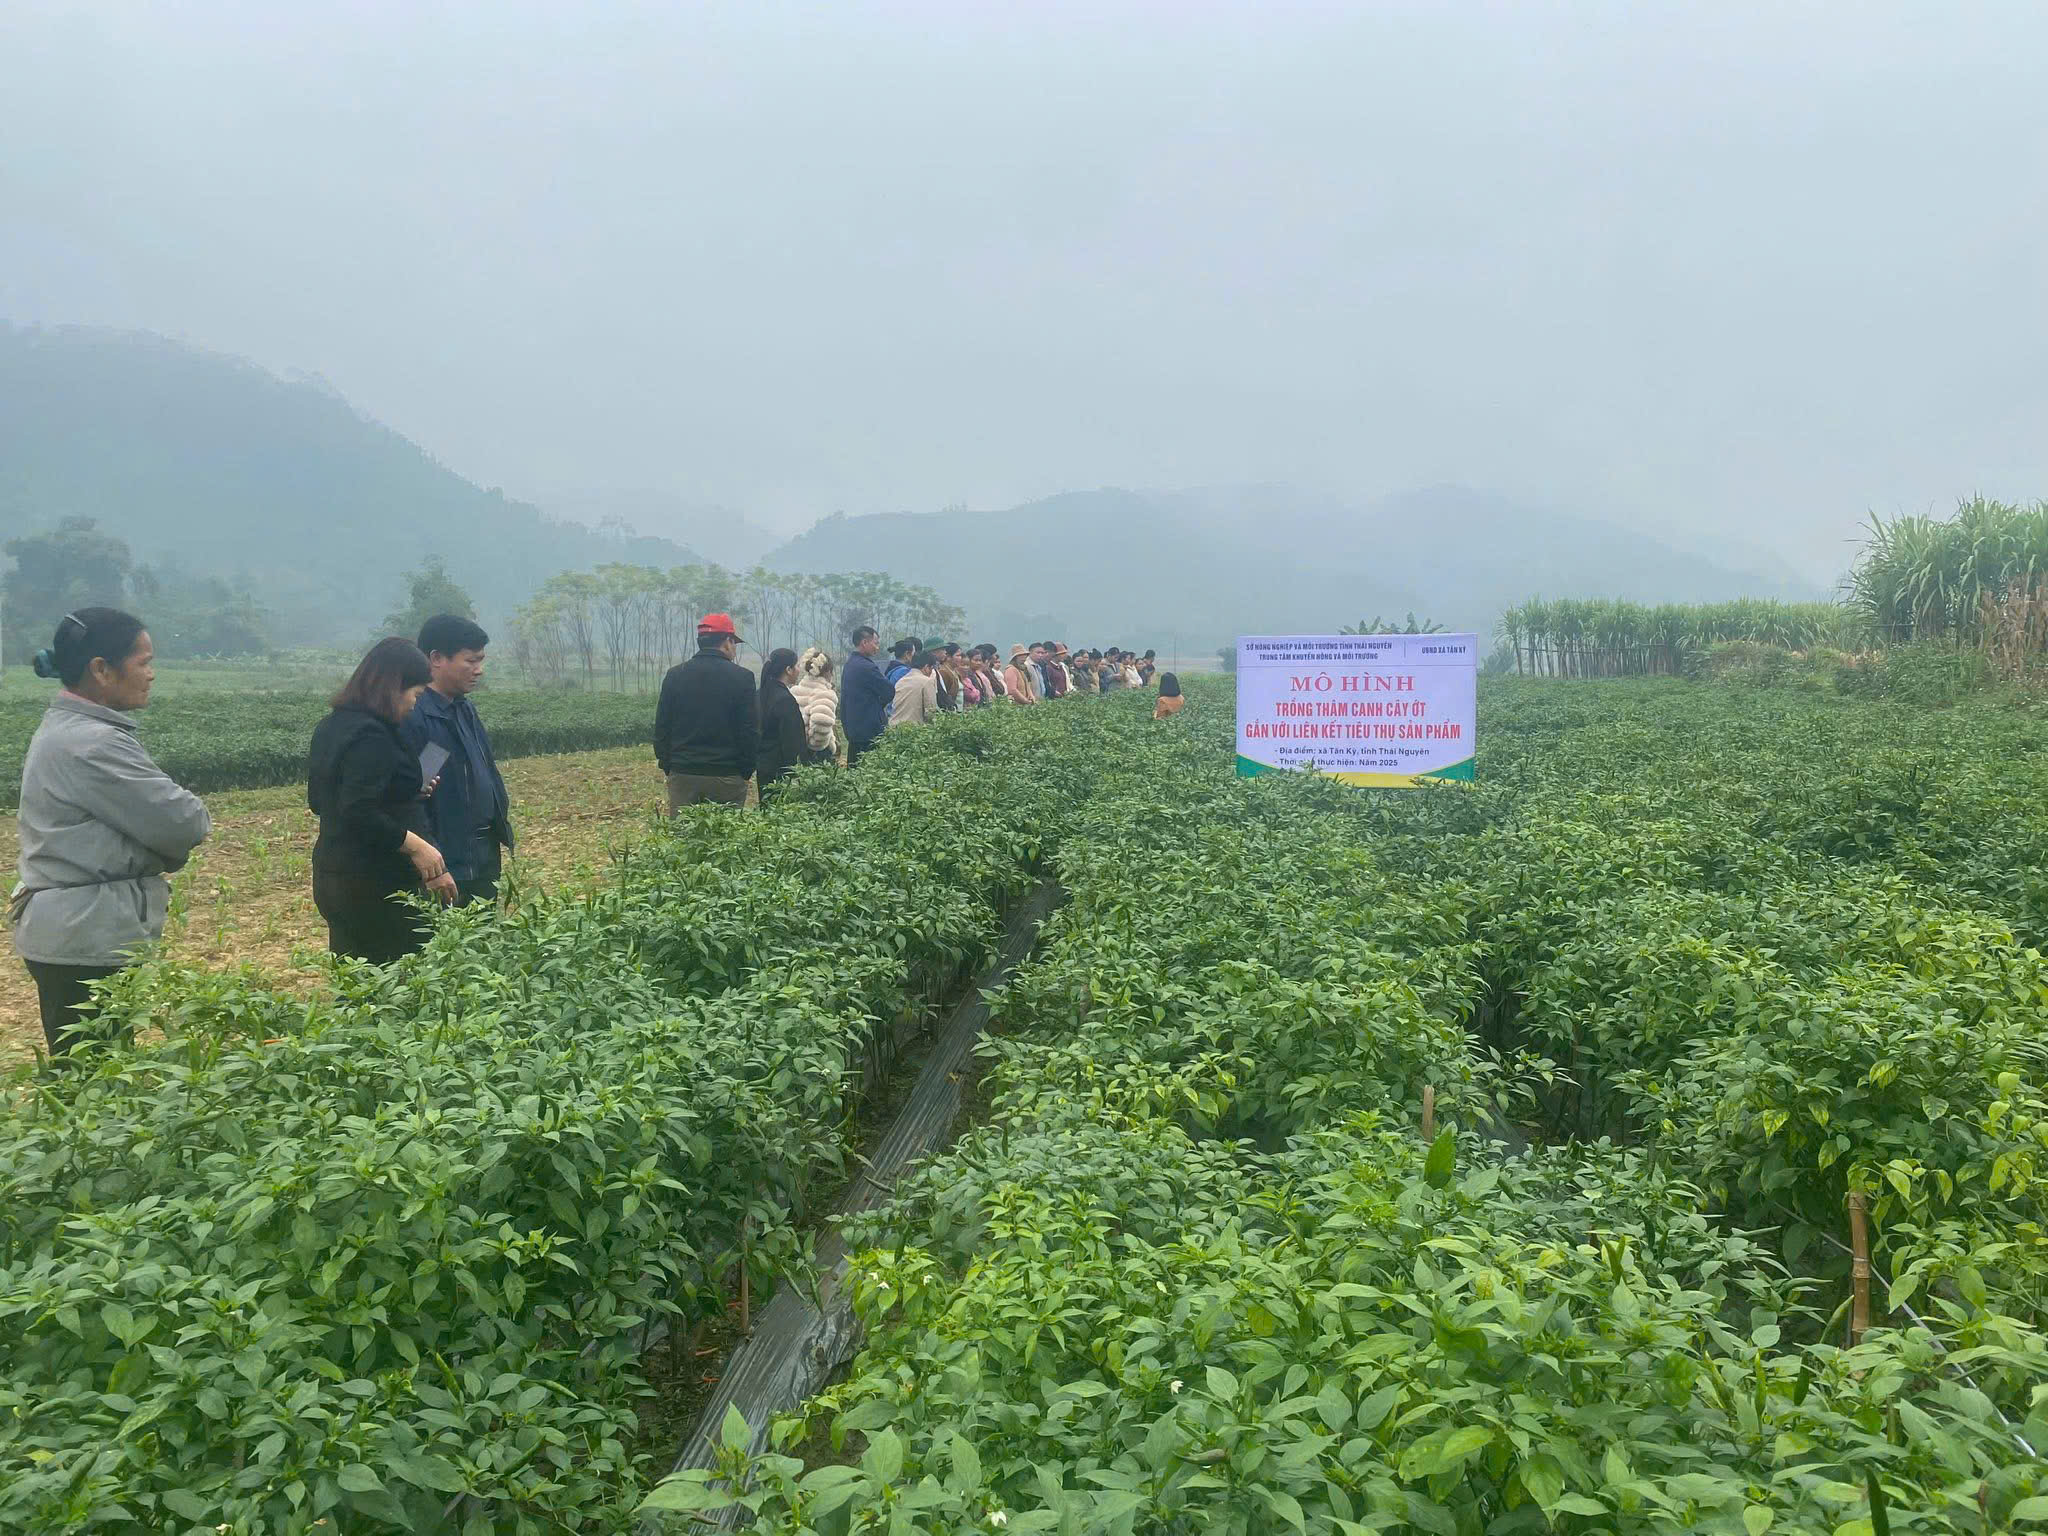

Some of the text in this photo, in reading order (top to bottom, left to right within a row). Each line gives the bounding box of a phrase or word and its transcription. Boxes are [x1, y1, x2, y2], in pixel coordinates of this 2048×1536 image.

[1259, 653, 1278, 661] TRUNG
[1290, 672, 1415, 691] MÔ HÌNH
[1276, 698, 1426, 717] TRỒNG THÂM CANH CÂY ỚT
[1246, 719, 1460, 742] GẮN VỚI LIÊN KẾT TIÊU THỤ SẢN PHẨM
[1279, 747, 1292, 756] Địa
[1329, 747, 1344, 755] Tân
[1379, 747, 1396, 755] Thái
[1399, 747, 1429, 756] Nguyên
[1317, 758, 1335, 766] thực
[1359, 758, 1377, 766] Năm
[1379, 759, 1398, 767] 2025
